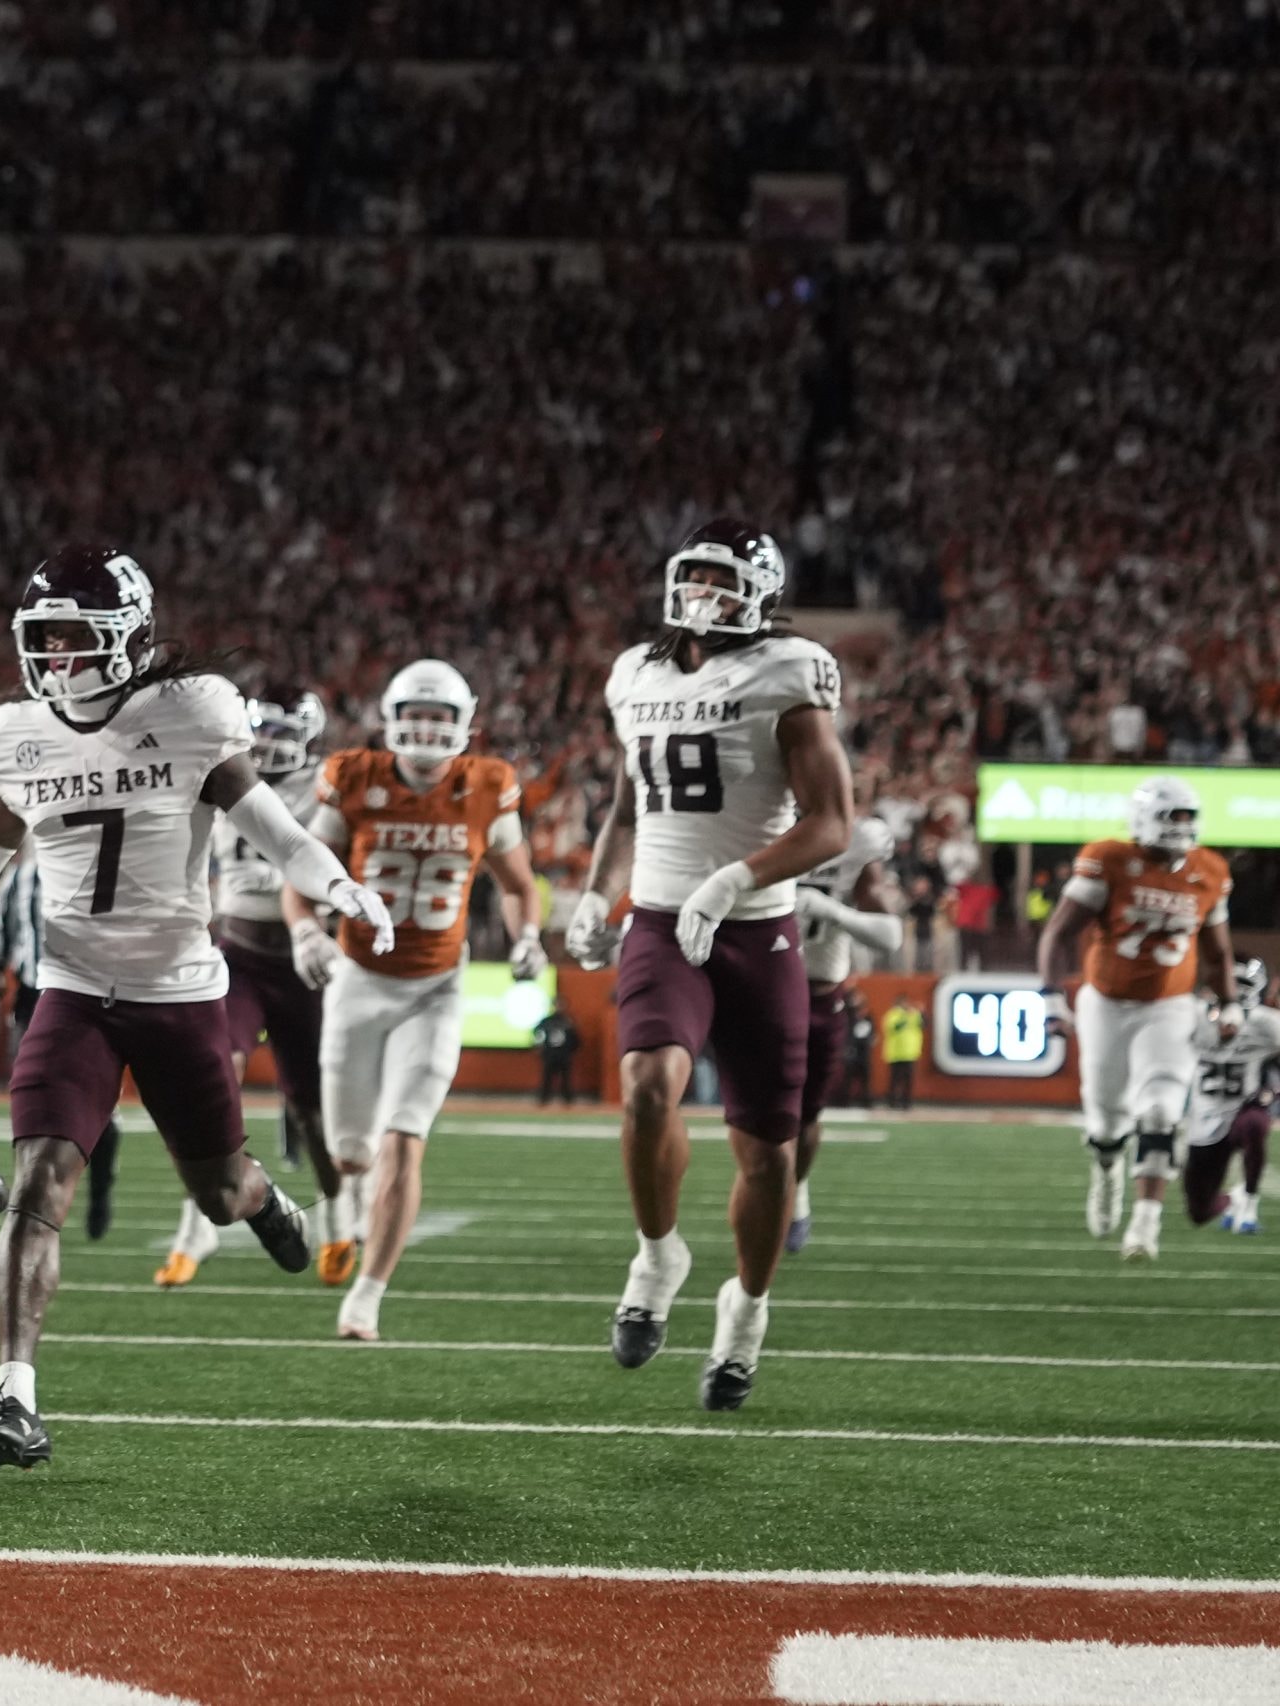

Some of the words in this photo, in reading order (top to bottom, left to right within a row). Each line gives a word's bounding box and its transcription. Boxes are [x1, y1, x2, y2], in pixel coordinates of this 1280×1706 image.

[631, 701, 685, 723] TEXAS
[694, 700, 742, 722] A&M
[24, 770, 104, 807] TEXAS
[116, 762, 173, 795] A&M
[638, 733, 725, 813] 18
[62, 807, 125, 915] 7
[373, 821, 469, 851] TEXAS
[953, 990, 1046, 1061] 40
